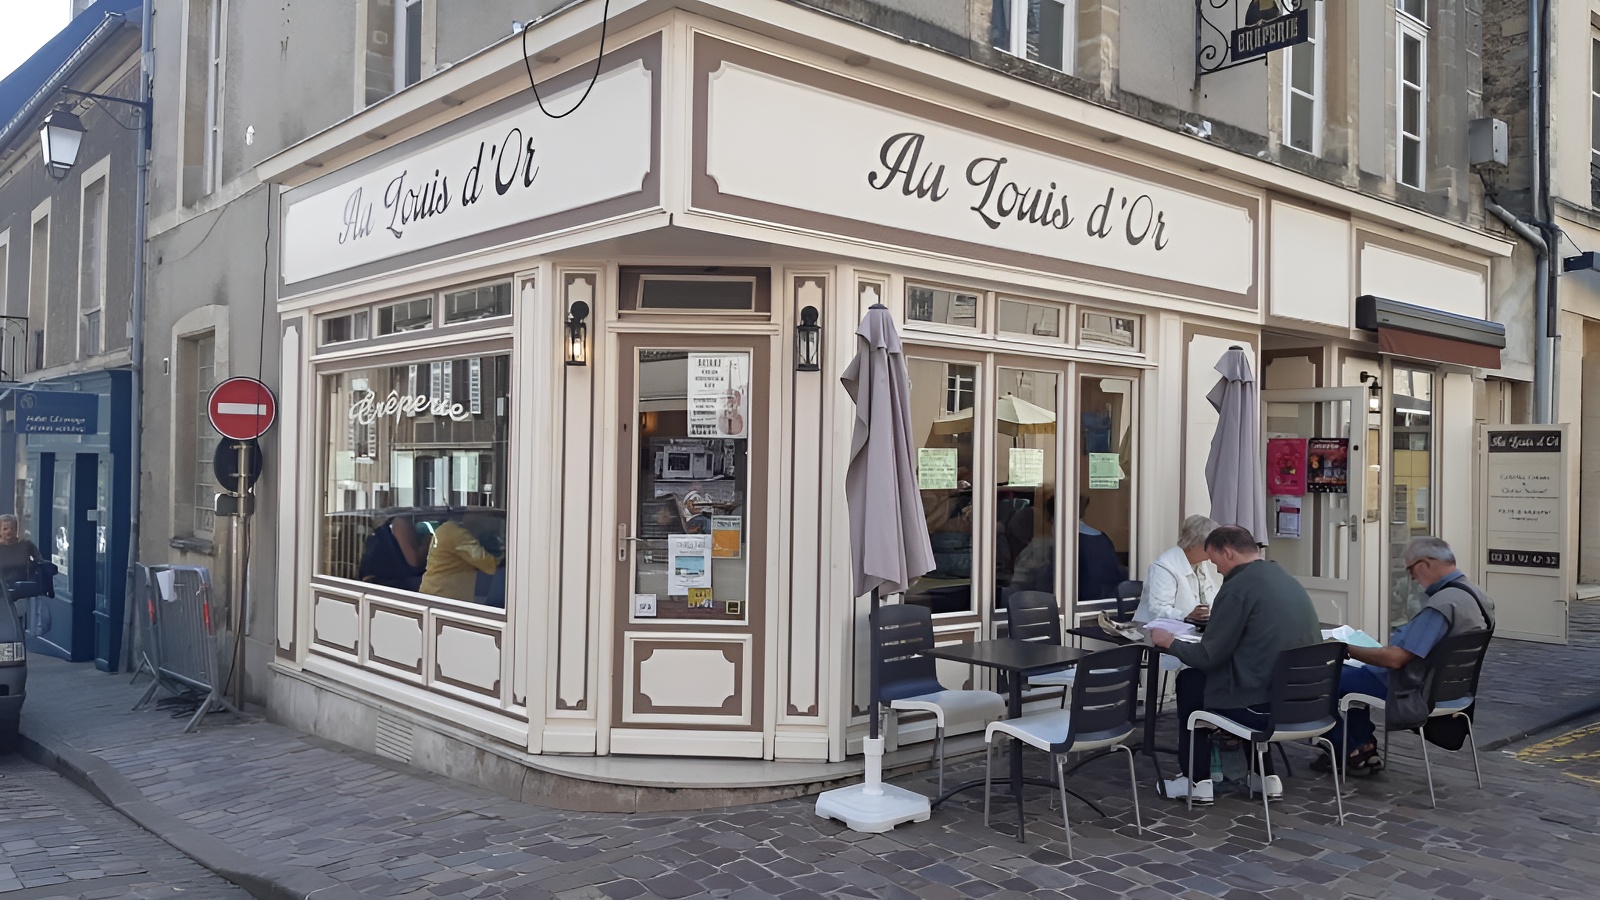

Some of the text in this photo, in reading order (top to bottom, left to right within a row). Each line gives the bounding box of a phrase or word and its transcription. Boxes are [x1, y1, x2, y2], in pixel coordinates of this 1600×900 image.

[338, 127, 540, 245] Au Louis d'Or
[867, 131, 1169, 251] Au Louis d'Or
[348, 388, 470, 426] Crêperie
